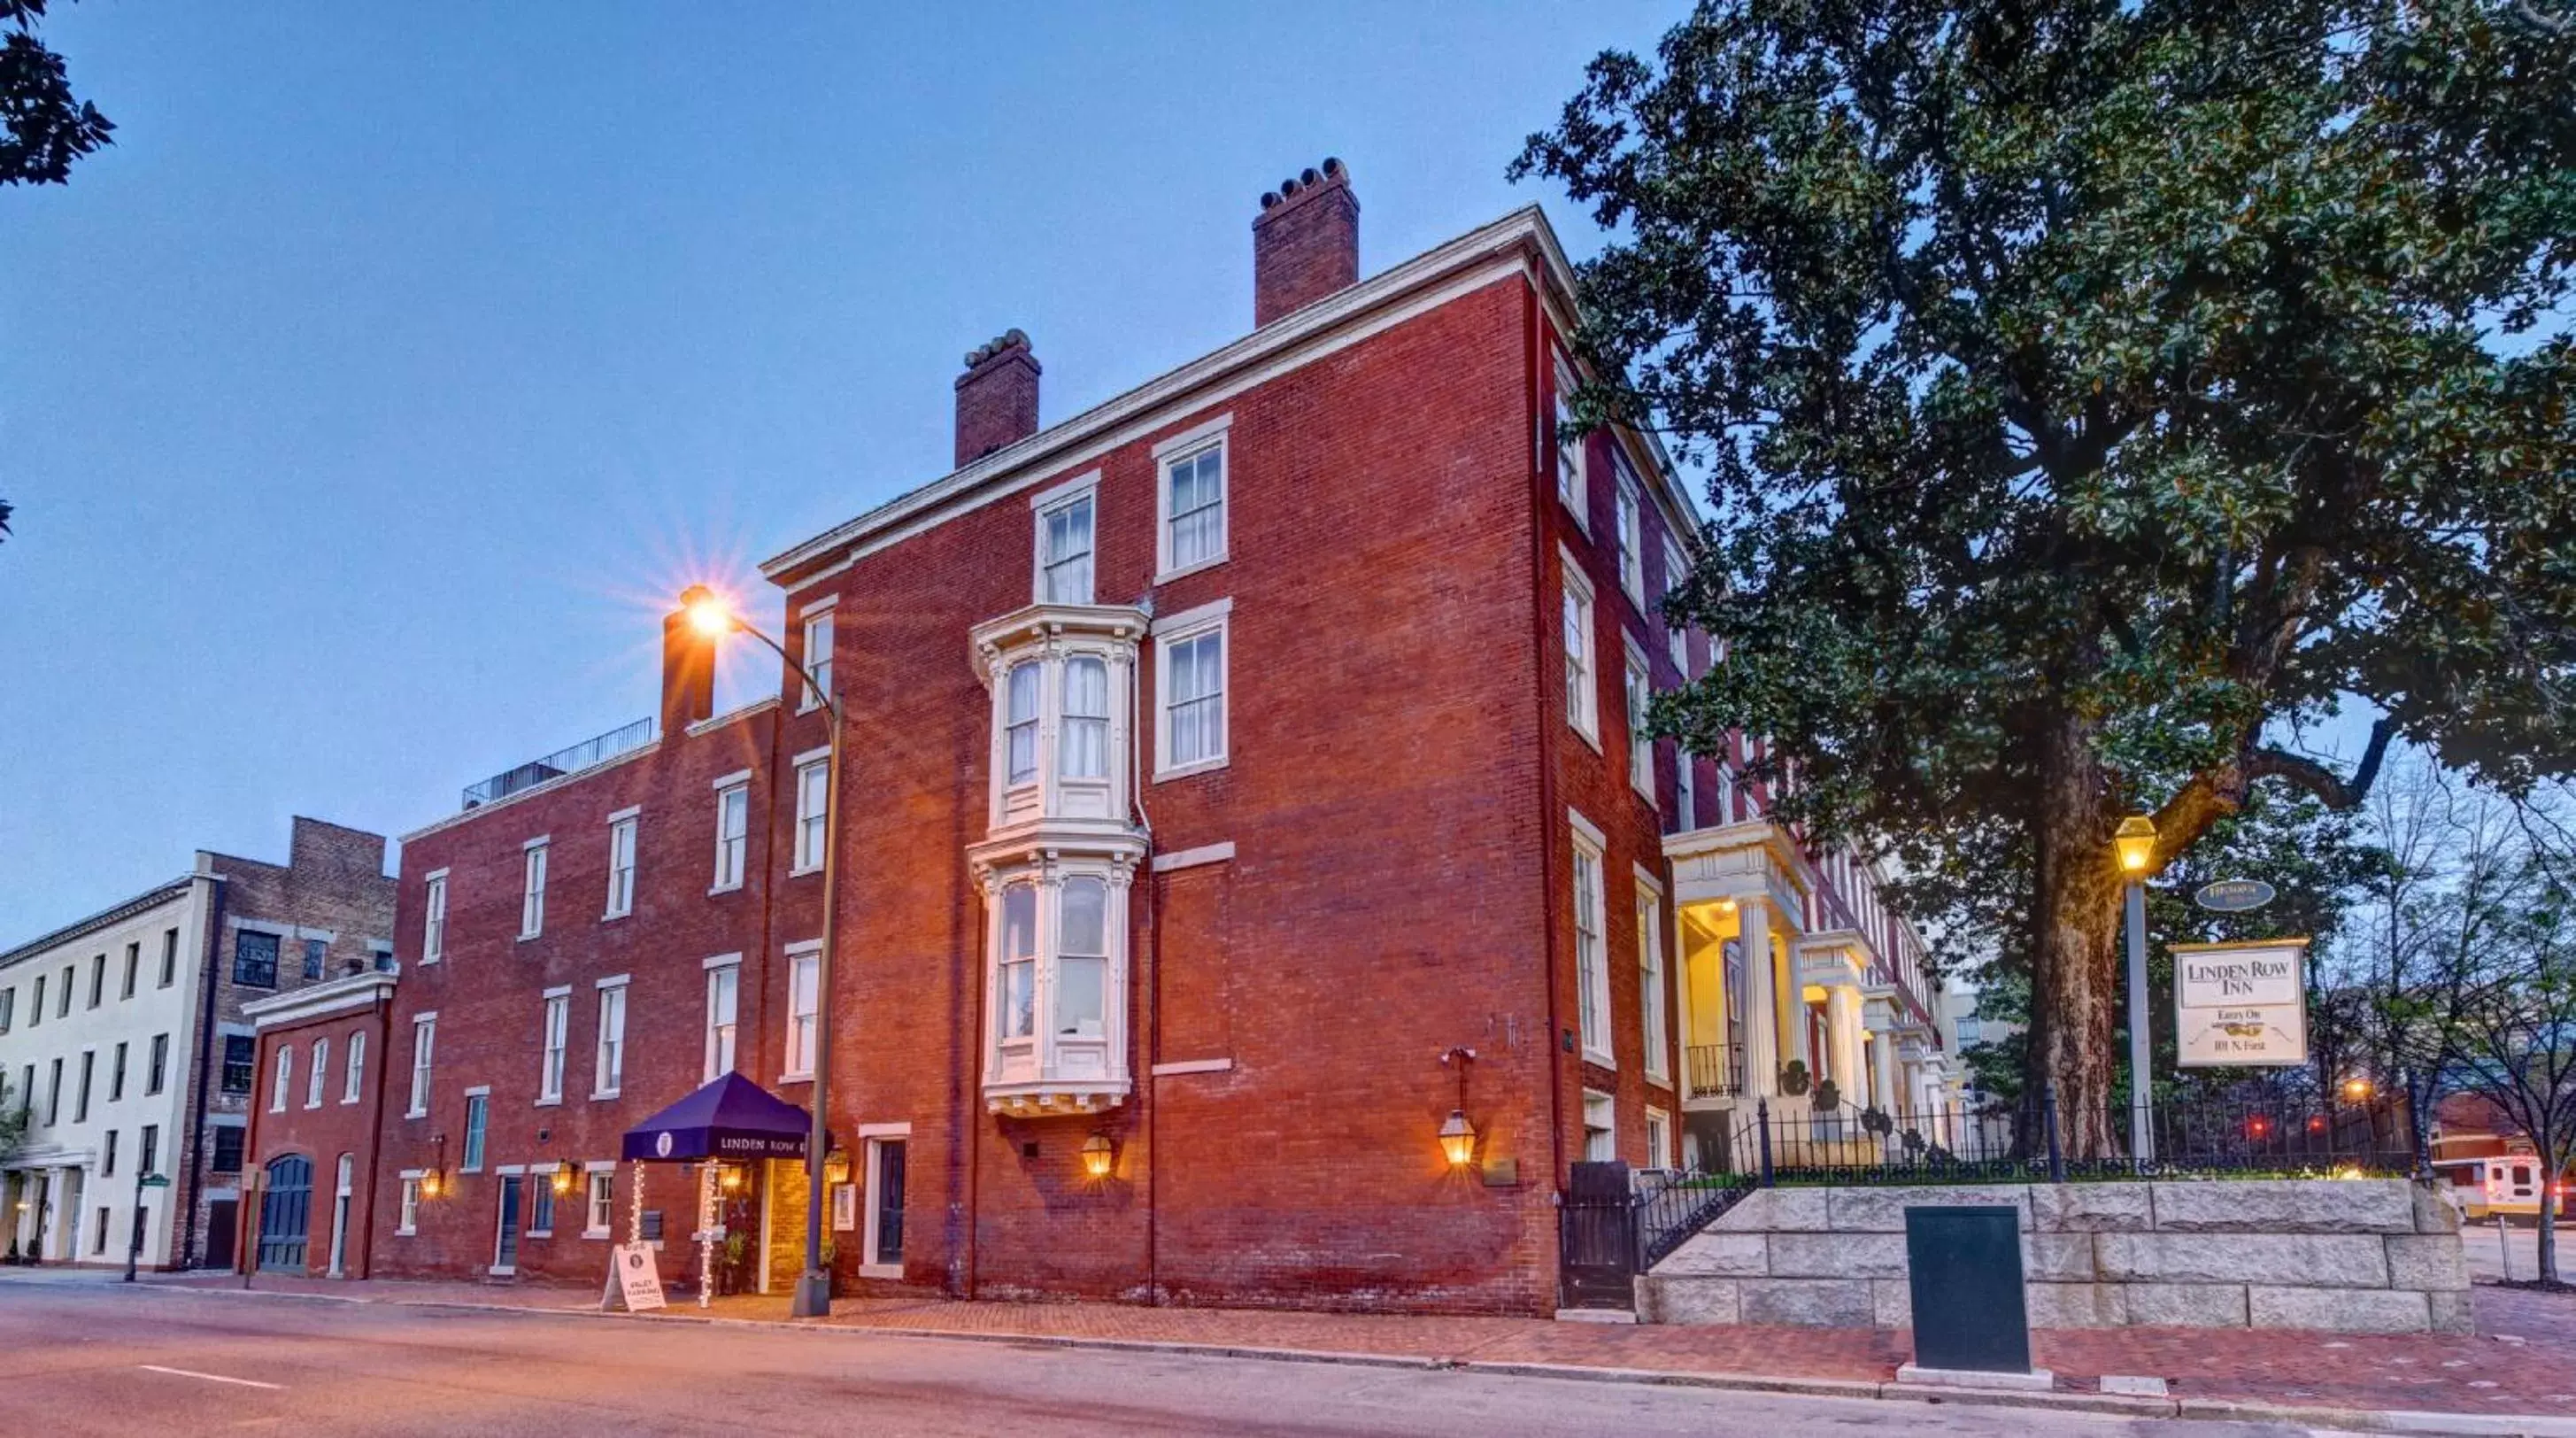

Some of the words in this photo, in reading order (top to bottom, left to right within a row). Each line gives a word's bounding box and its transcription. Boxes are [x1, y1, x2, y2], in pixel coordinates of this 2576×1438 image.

[2188, 963, 2248, 979] LINDEN
[2251, 961, 2289, 977] ROW
[2223, 979, 2254, 995] INN
[721, 1137, 765, 1150] LINDEN
[770, 1140, 795, 1152] ROW
